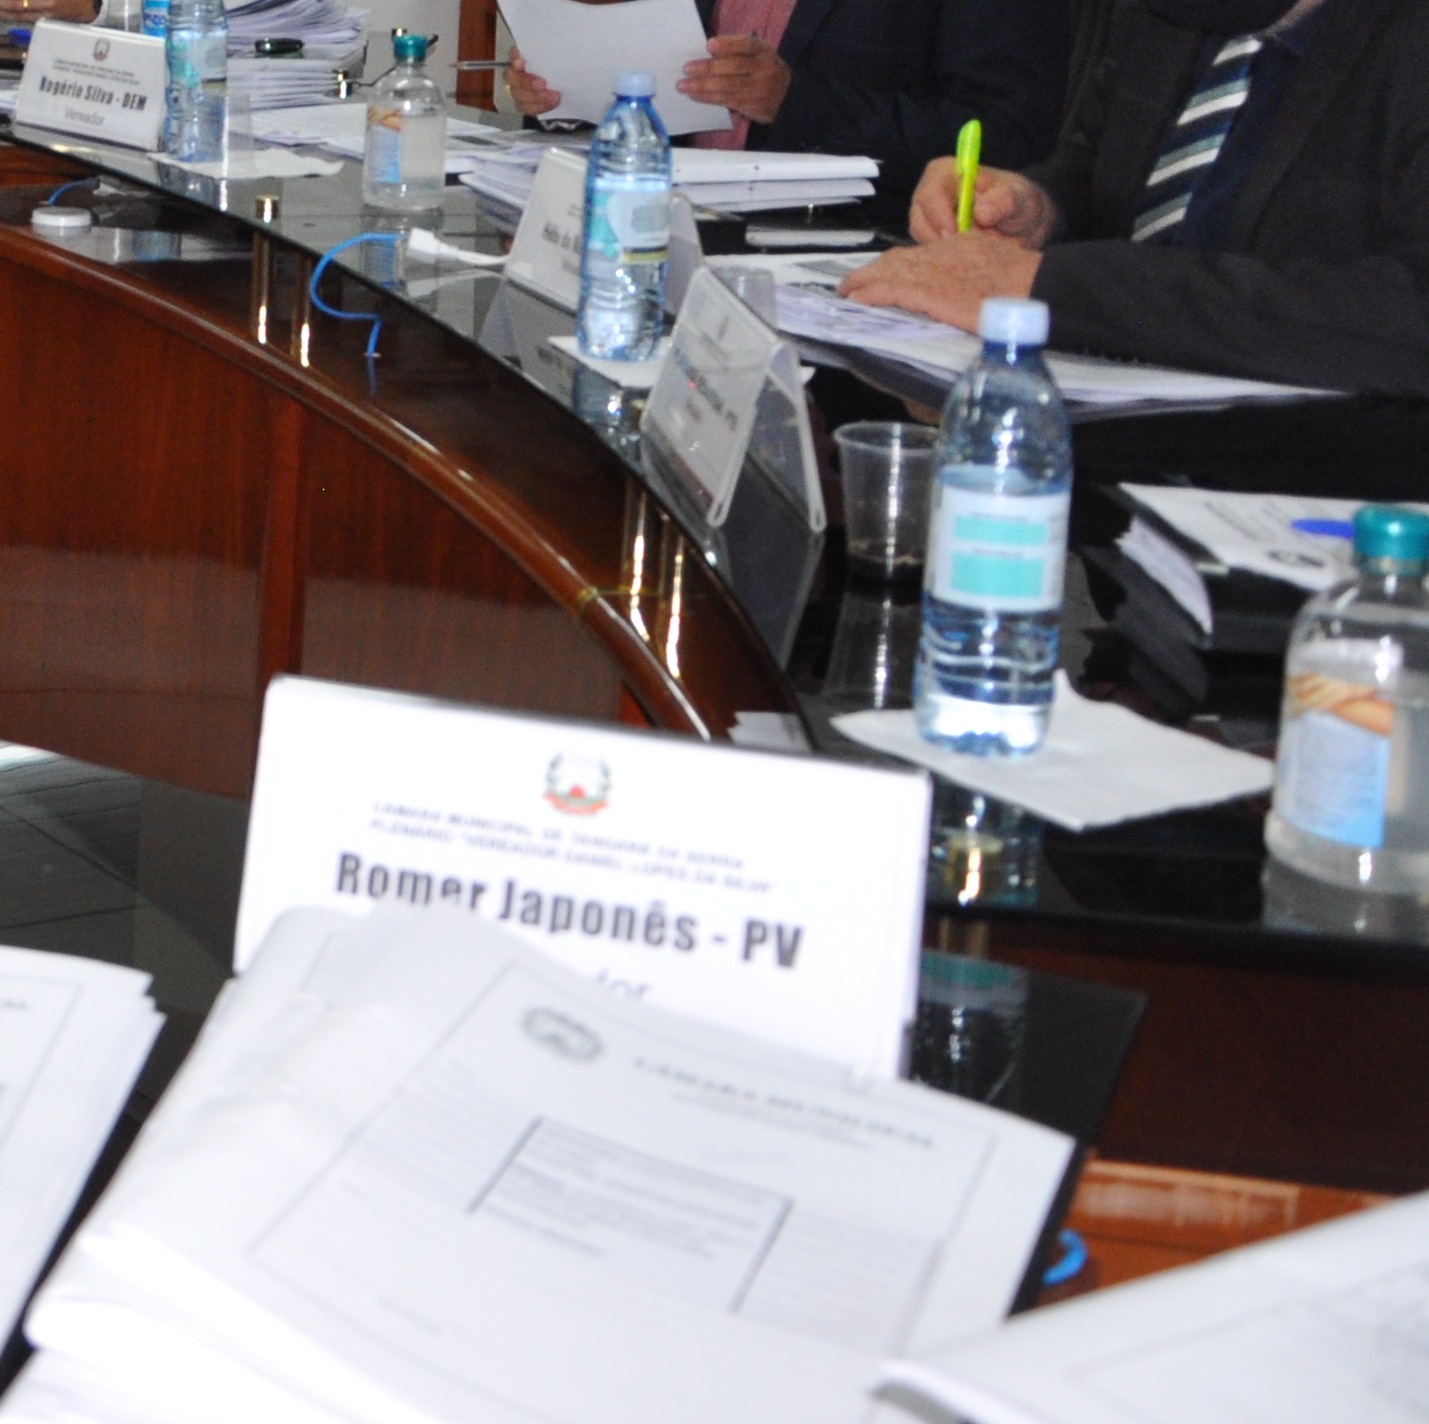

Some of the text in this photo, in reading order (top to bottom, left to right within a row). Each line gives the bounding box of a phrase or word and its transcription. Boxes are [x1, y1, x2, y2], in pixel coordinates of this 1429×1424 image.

[39, 76, 84, 99] Rogério
[84, 84, 115, 105] Silva
[122, 91, 148, 111] DEM
[335, 852, 488, 911] Romer
[498, 880, 699, 952] Japonês
[741, 919, 804, 969] PV
